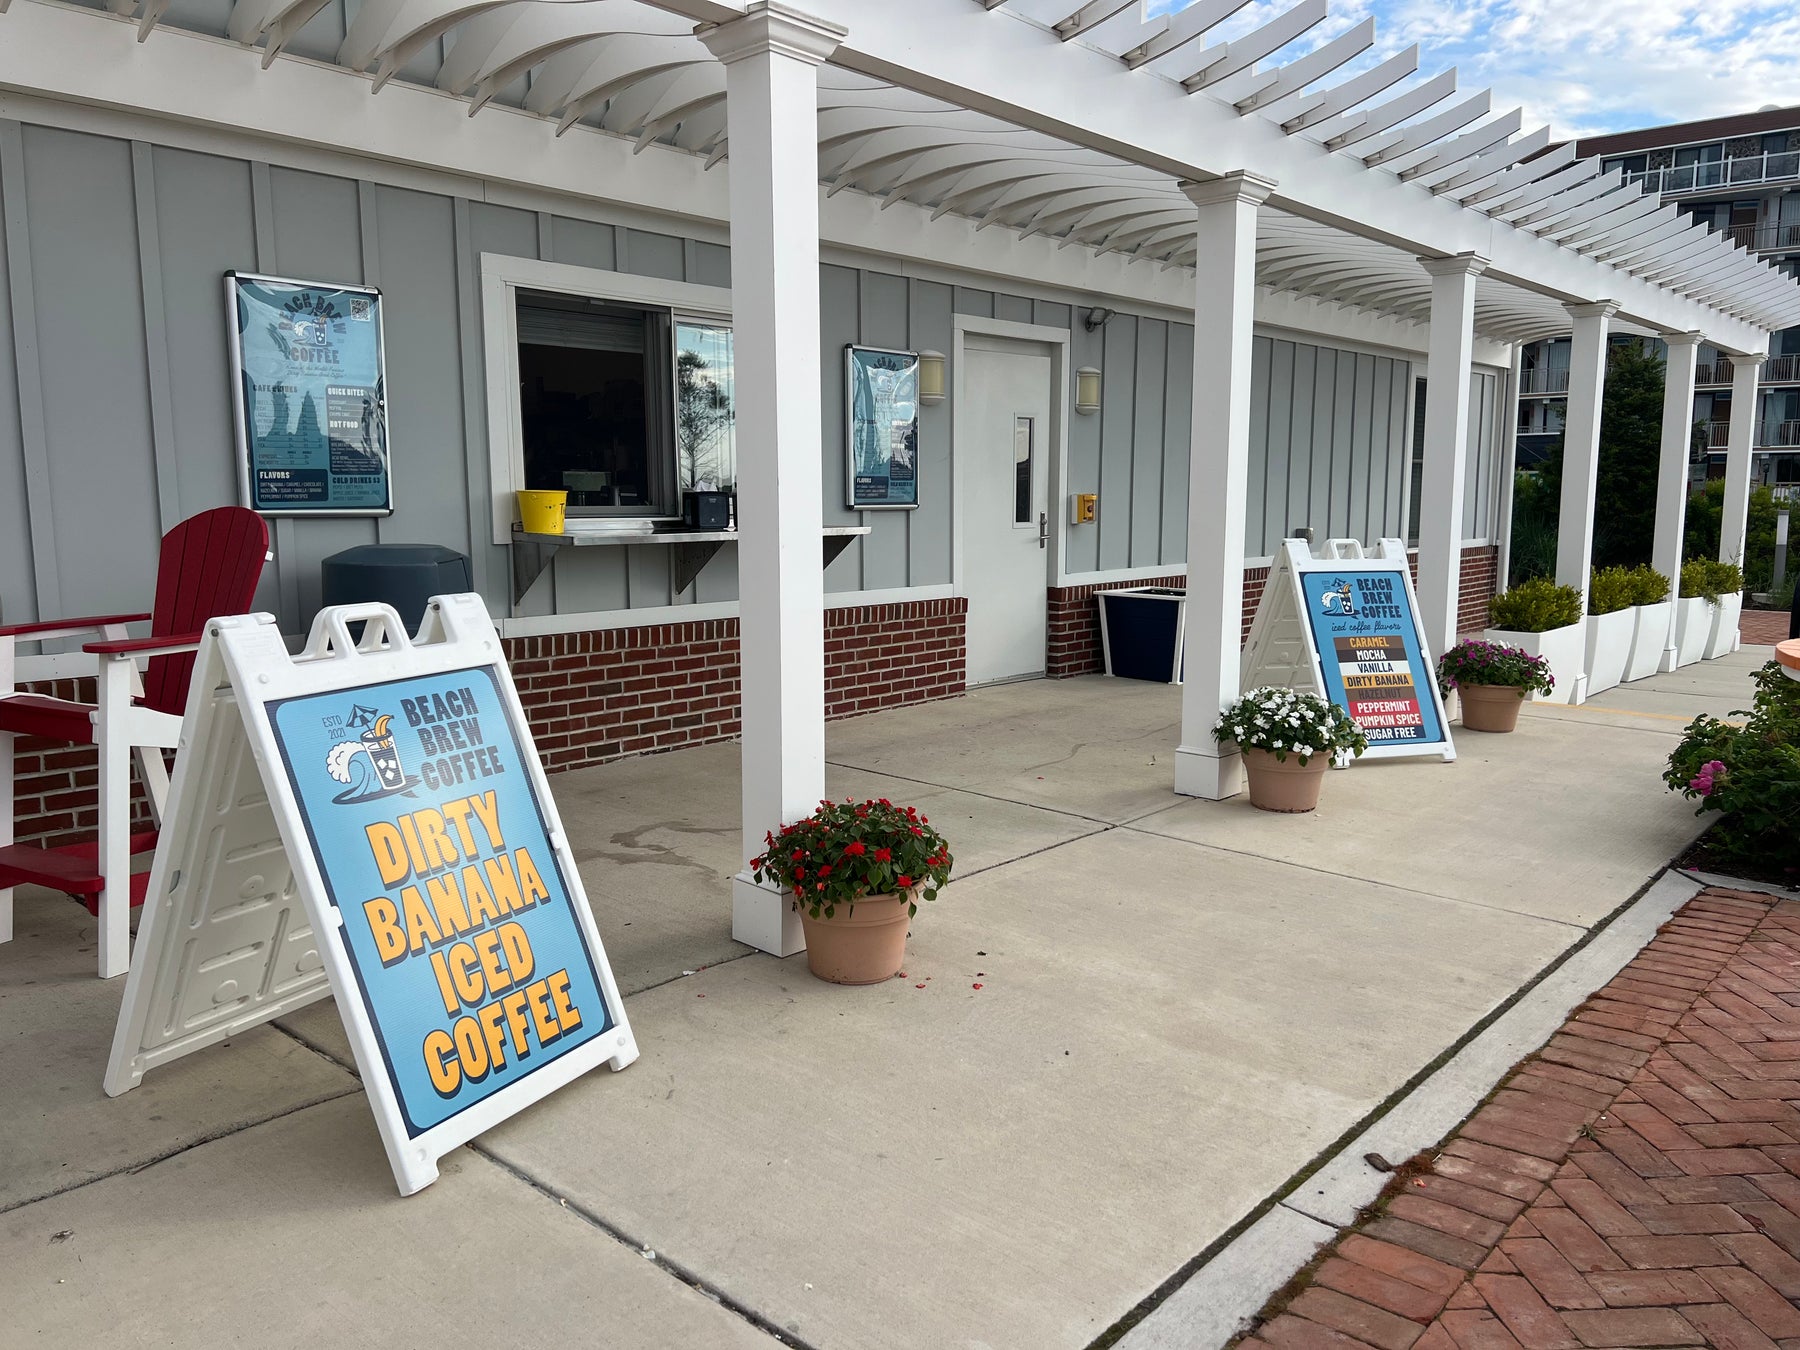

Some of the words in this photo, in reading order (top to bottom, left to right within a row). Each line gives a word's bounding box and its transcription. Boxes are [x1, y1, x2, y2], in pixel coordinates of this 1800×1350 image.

[290, 347, 340, 364] COFFEE
[327, 387, 346, 396] QUICK
[346, 388, 364, 397] BITES
[329, 420, 342, 428] HOT
[343, 420, 359, 429] FOOD
[260, 471, 290, 479] FLAVORS
[332, 476, 349, 484] COLD
[350, 476, 371, 484] DRINKS
[1356, 578, 1393, 591] BEACH
[1362, 592, 1393, 604] BREW
[1361, 605, 1402, 619] COFFEE
[1331, 622, 1346, 632] iced
[1349, 621, 1371, 633] coffee
[1373, 620, 1402, 633] flavors
[1349, 637, 1389, 648] CARAMEL
[1356, 650, 1387, 660] MOCHA
[1357, 662, 1394, 673] VANILLA
[1347, 675, 1373, 687] DIRTY
[1375, 674, 1410, 686] BANANA
[1358, 688, 1402, 700] HAZELNUT
[400, 688, 480, 727] BEACH
[1357, 701, 1411, 713] PEPPERMINT
[1356, 714, 1395, 727] PUMPKIN
[1396, 713, 1422, 725] SPICE
[328, 727, 346, 740] 2021
[417, 717, 484, 757] BREW
[1364, 728, 1394, 740] SUGAR
[1394, 727, 1417, 738] FREE
[420, 745, 505, 790] COFFEE
[364, 789, 507, 891] DIRTY
[362, 847, 551, 969] BANANA
[429, 922, 535, 1019] ICED
[422, 968, 583, 1100] COFFEE
